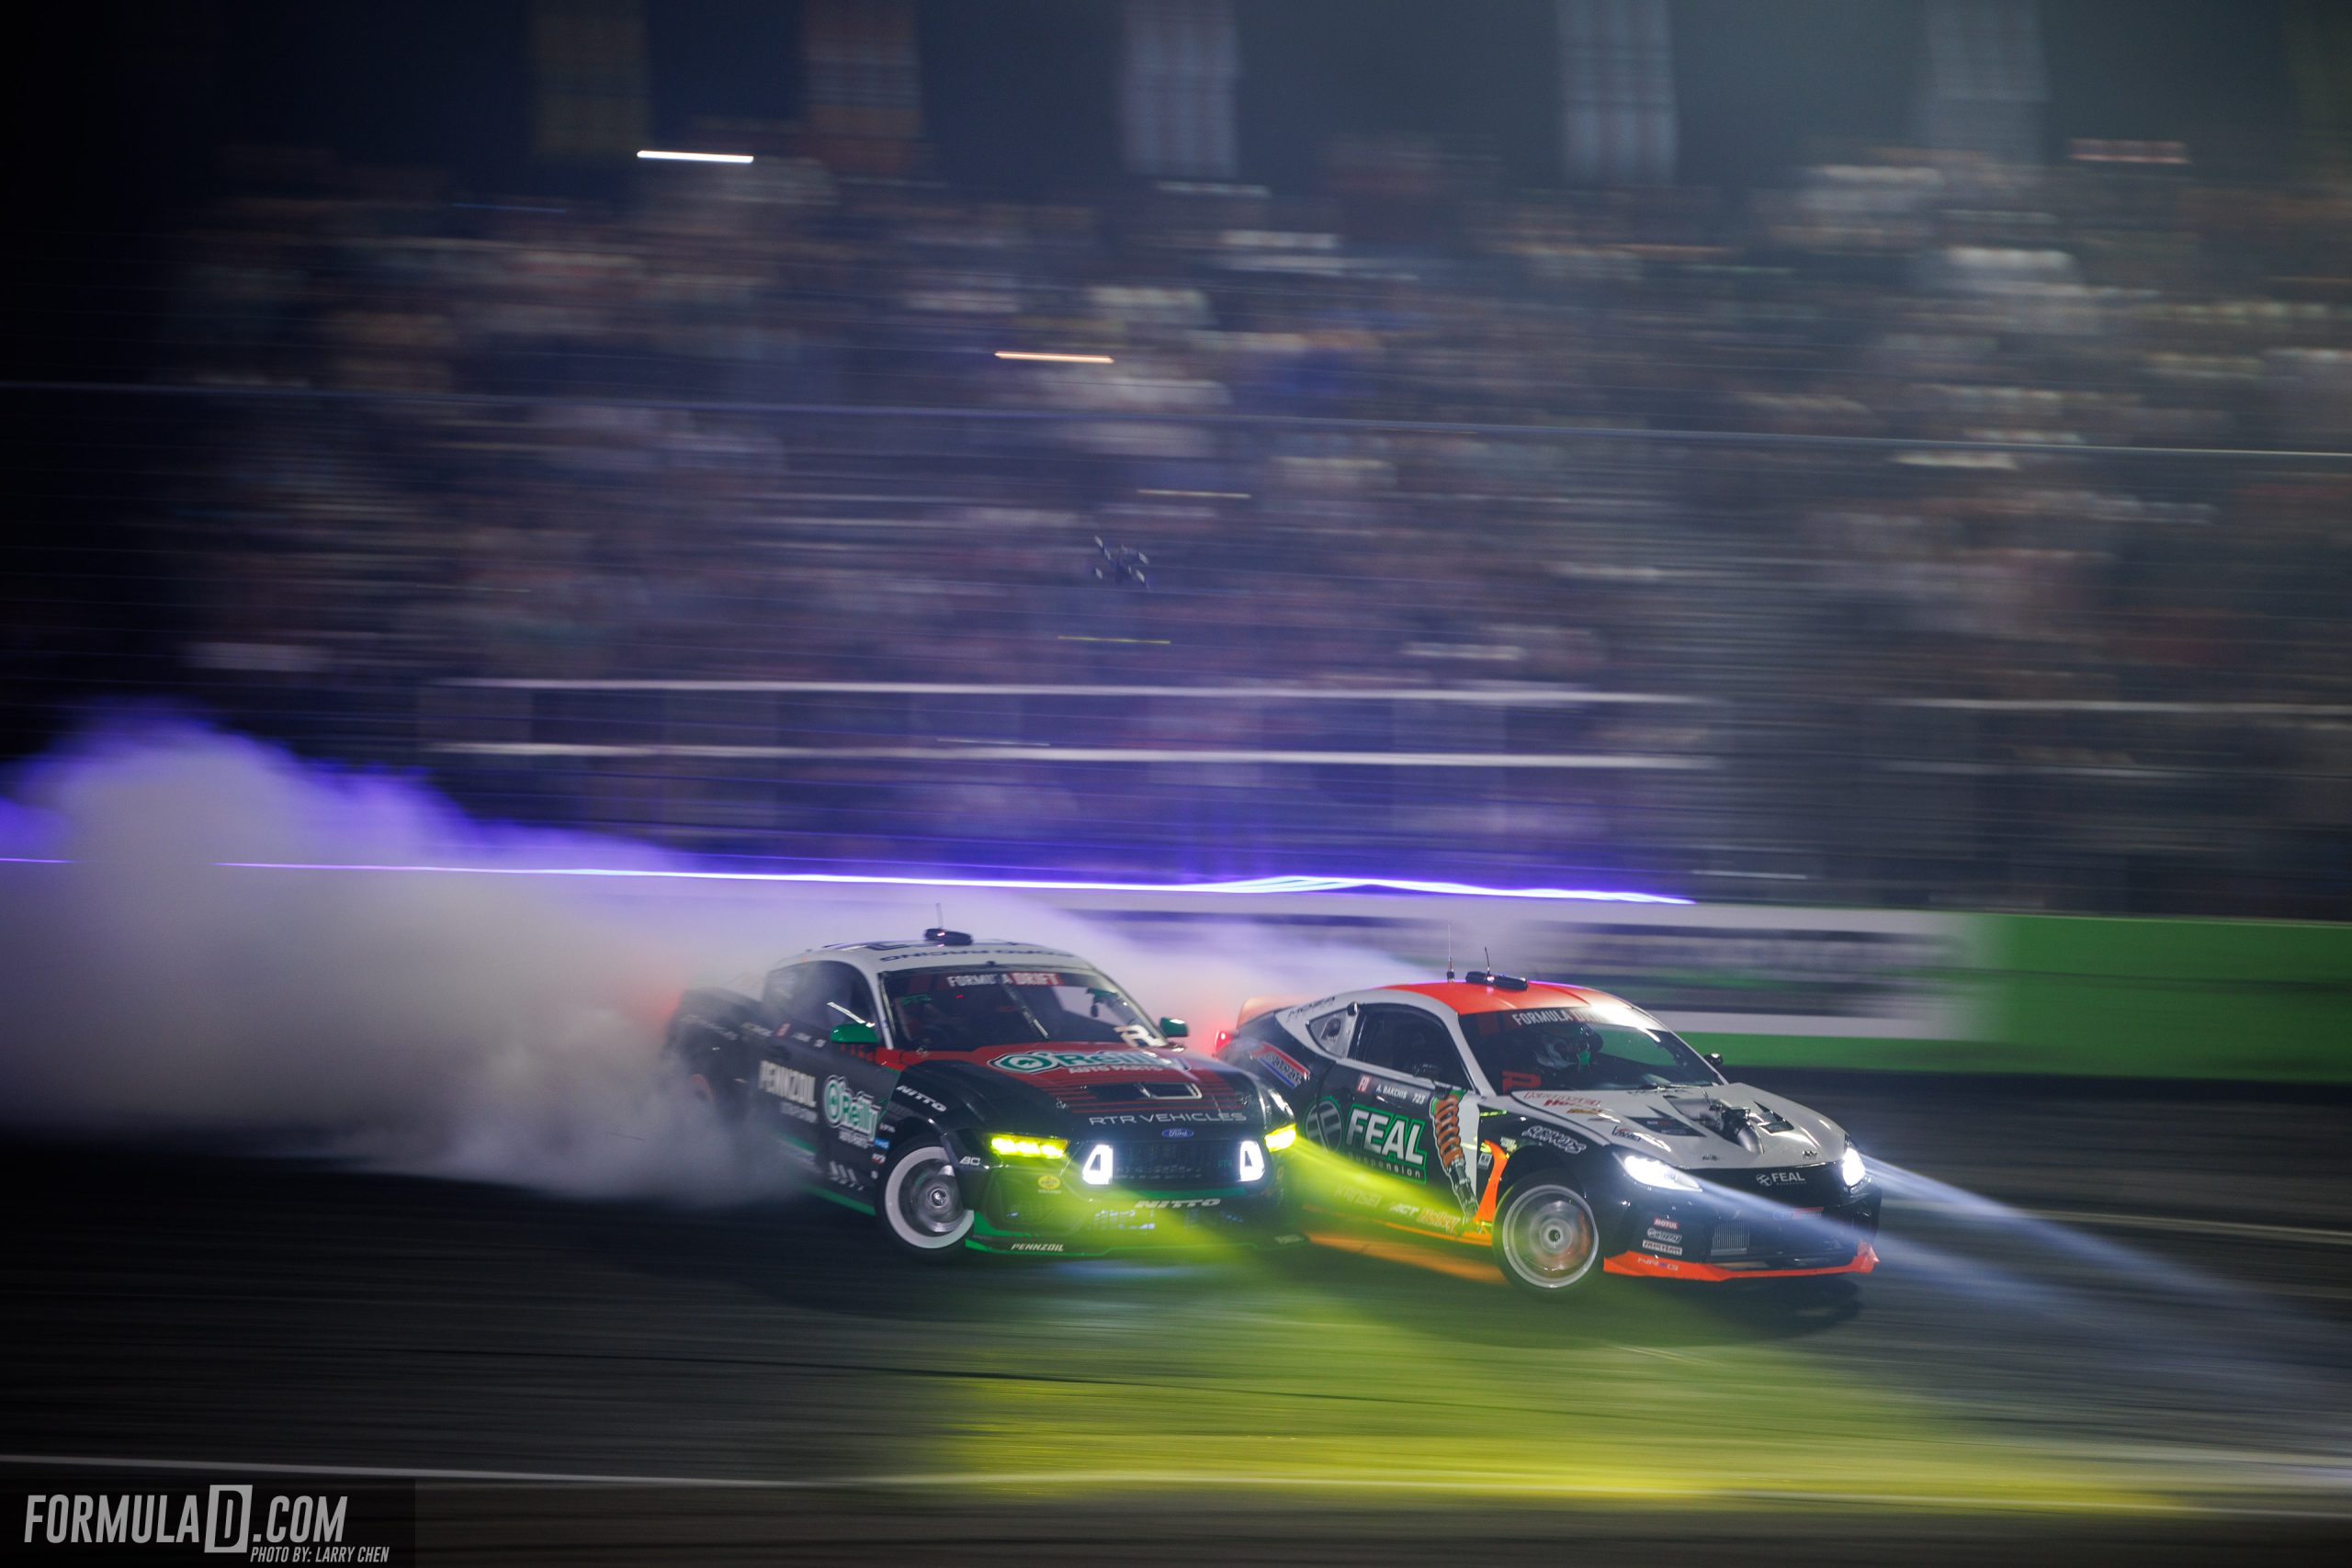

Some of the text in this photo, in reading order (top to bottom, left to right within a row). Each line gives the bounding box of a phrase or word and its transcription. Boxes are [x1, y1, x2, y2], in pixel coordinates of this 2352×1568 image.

[1012, 973, 1060, 986] DRIFT
[1511, 1010, 1574, 1026] FORMULA
[896, 1084, 947, 1112] NITTO
[1089, 1112, 1247, 1126] RTR VEHICLES
[1167, 1128, 1189, 1139] Ford
[1346, 1108, 1424, 1165] FEAL
[1771, 1171, 1806, 1183] FEAL
[1134, 1198, 1222, 1209] NITTO
[1654, 1218, 1678, 1230] MOTUL
[1011, 1242, 1064, 1253] PENNZOIL
